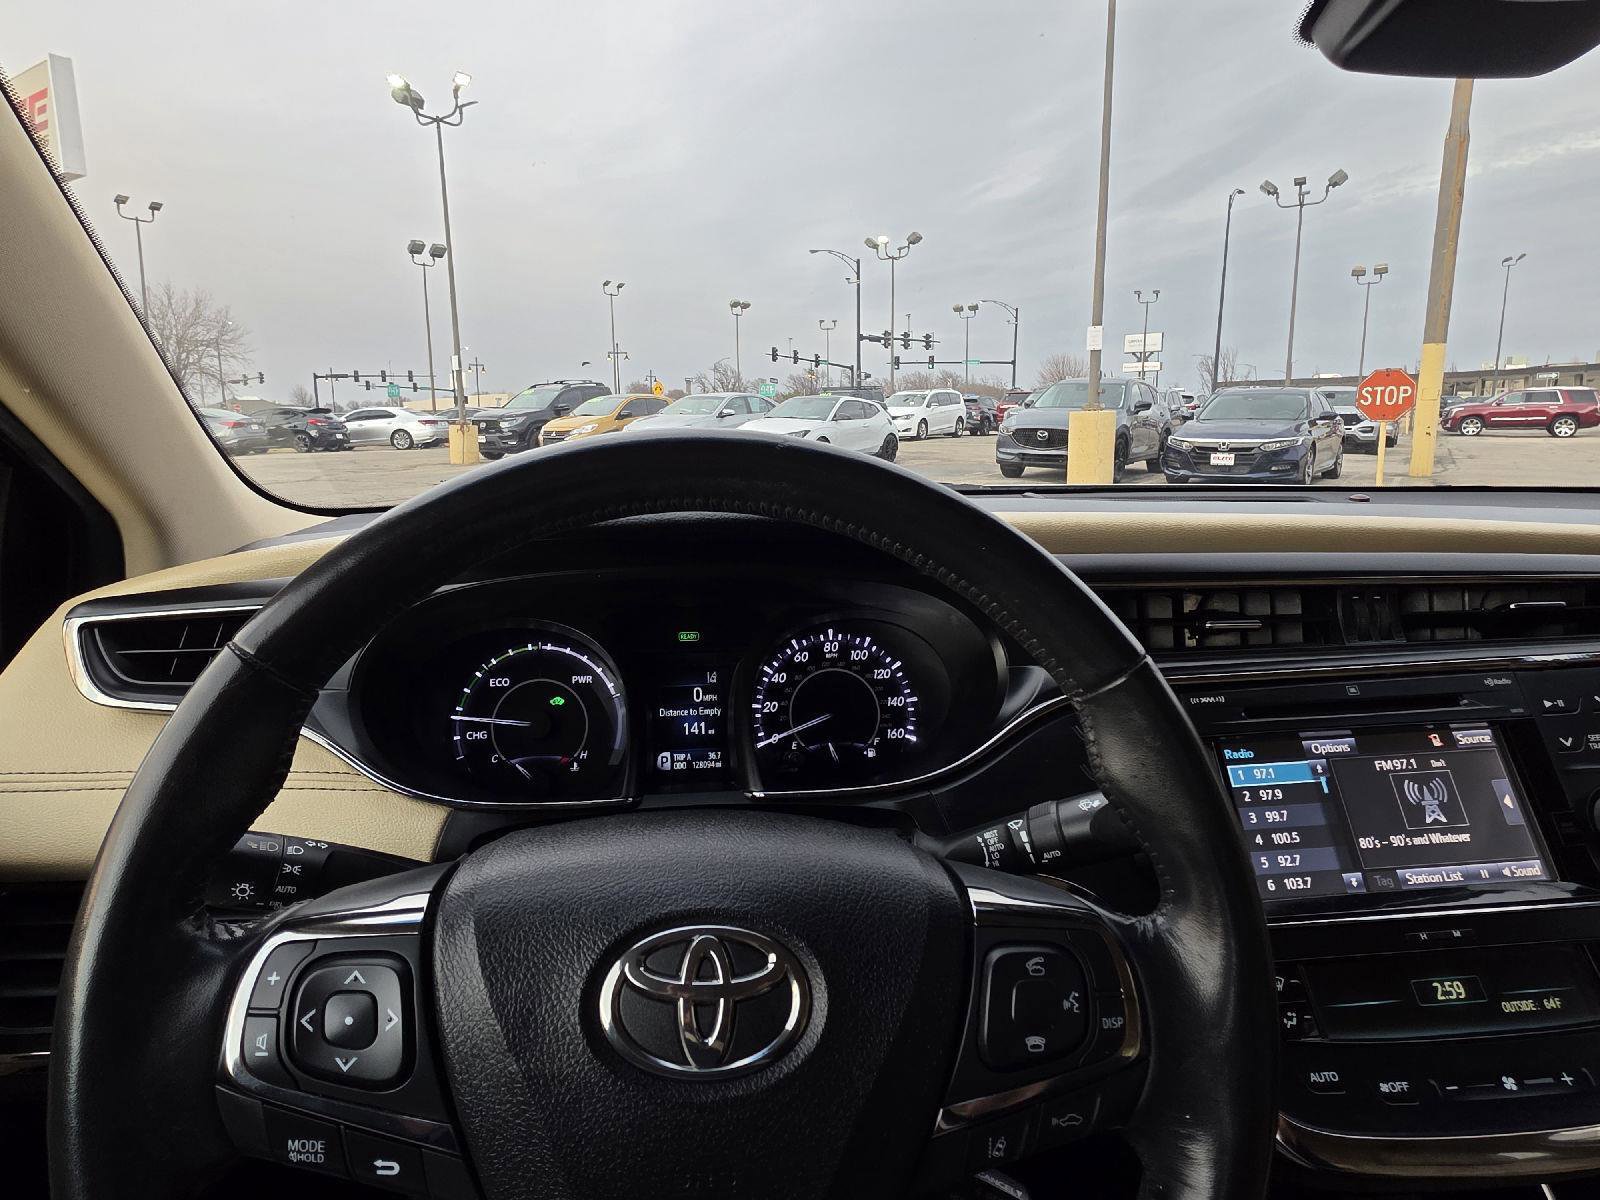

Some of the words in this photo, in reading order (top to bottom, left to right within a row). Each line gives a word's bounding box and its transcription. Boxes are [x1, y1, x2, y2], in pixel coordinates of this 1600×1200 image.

[1360, 385, 1412, 406] STOP
[823, 642, 839, 652] 80
[794, 652, 808, 662] 60
[850, 650, 868, 661] 100
[572, 675, 593, 684] PWR
[771, 673, 787, 683] 40
[873, 669, 891, 679] 120
[489, 678, 510, 687] ECO
[693, 687, 702, 702] 0
[703, 694, 717, 702] MPH
[887, 696, 904, 707] 140
[660, 708, 688, 717] Distance
[690, 708, 698, 716] to
[699, 707, 721, 718] Empty
[763, 702, 778, 713] 20
[683, 722, 705, 735] 141
[887, 728, 904, 739] 160
[466, 731, 488, 740] CHG
[1457, 734, 1492, 745] Source
[792, 742, 798, 750] E
[1311, 743, 1351, 755] Options
[491, 755, 498, 763] C
[579, 750, 588, 759] H
[673, 753, 685, 761] TRIP
[686, 753, 691, 761] A
[707, 752, 721, 760] 36.7
[1224, 749, 1254, 760] Radio
[692, 761, 715, 769] 128094
[1238, 770, 1245, 781] 1
[1253, 768, 1275, 779] 97.1
[1243, 791, 1251, 802] 2
[1259, 789, 1283, 801] 97.9
[1248, 812, 1257, 823] 3
[1265, 810, 1288, 822] 99.7
[983, 829, 999, 839] MIST
[1255, 834, 1263, 845] 4
[1271, 832, 1300, 844] 100.5
[987, 837, 998, 845] OFF
[1359, 837, 1381, 849] 80's
[1390, 833, 1411, 847] 90's
[1412, 833, 1429, 845] and
[1429, 832, 1471, 844] Whatever
[989, 843, 1005, 852] AUTO
[991, 852, 1000, 860] LO
[1043, 850, 1061, 859] AUTO
[1260, 857, 1269, 868] 5
[1277, 855, 1300, 867] 92.7
[1512, 864, 1541, 877] Sound
[1374, 875, 1395, 888] Tag
[1406, 871, 1443, 885] Station
[1443, 870, 1464, 882] List
[1267, 880, 1276, 891] 6
[1284, 877, 1312, 890] 103.7
[275, 886, 297, 894] AUTO
[1432, 981, 1466, 1000] 2:59
[1102, 1016, 1124, 1029] DISP
[1309, 1071, 1339, 1084] AUTO
[1388, 1081, 1410, 1093] OFF
[287, 1139, 326, 1153] MODE
[297, 1153, 325, 1164] HOLD
